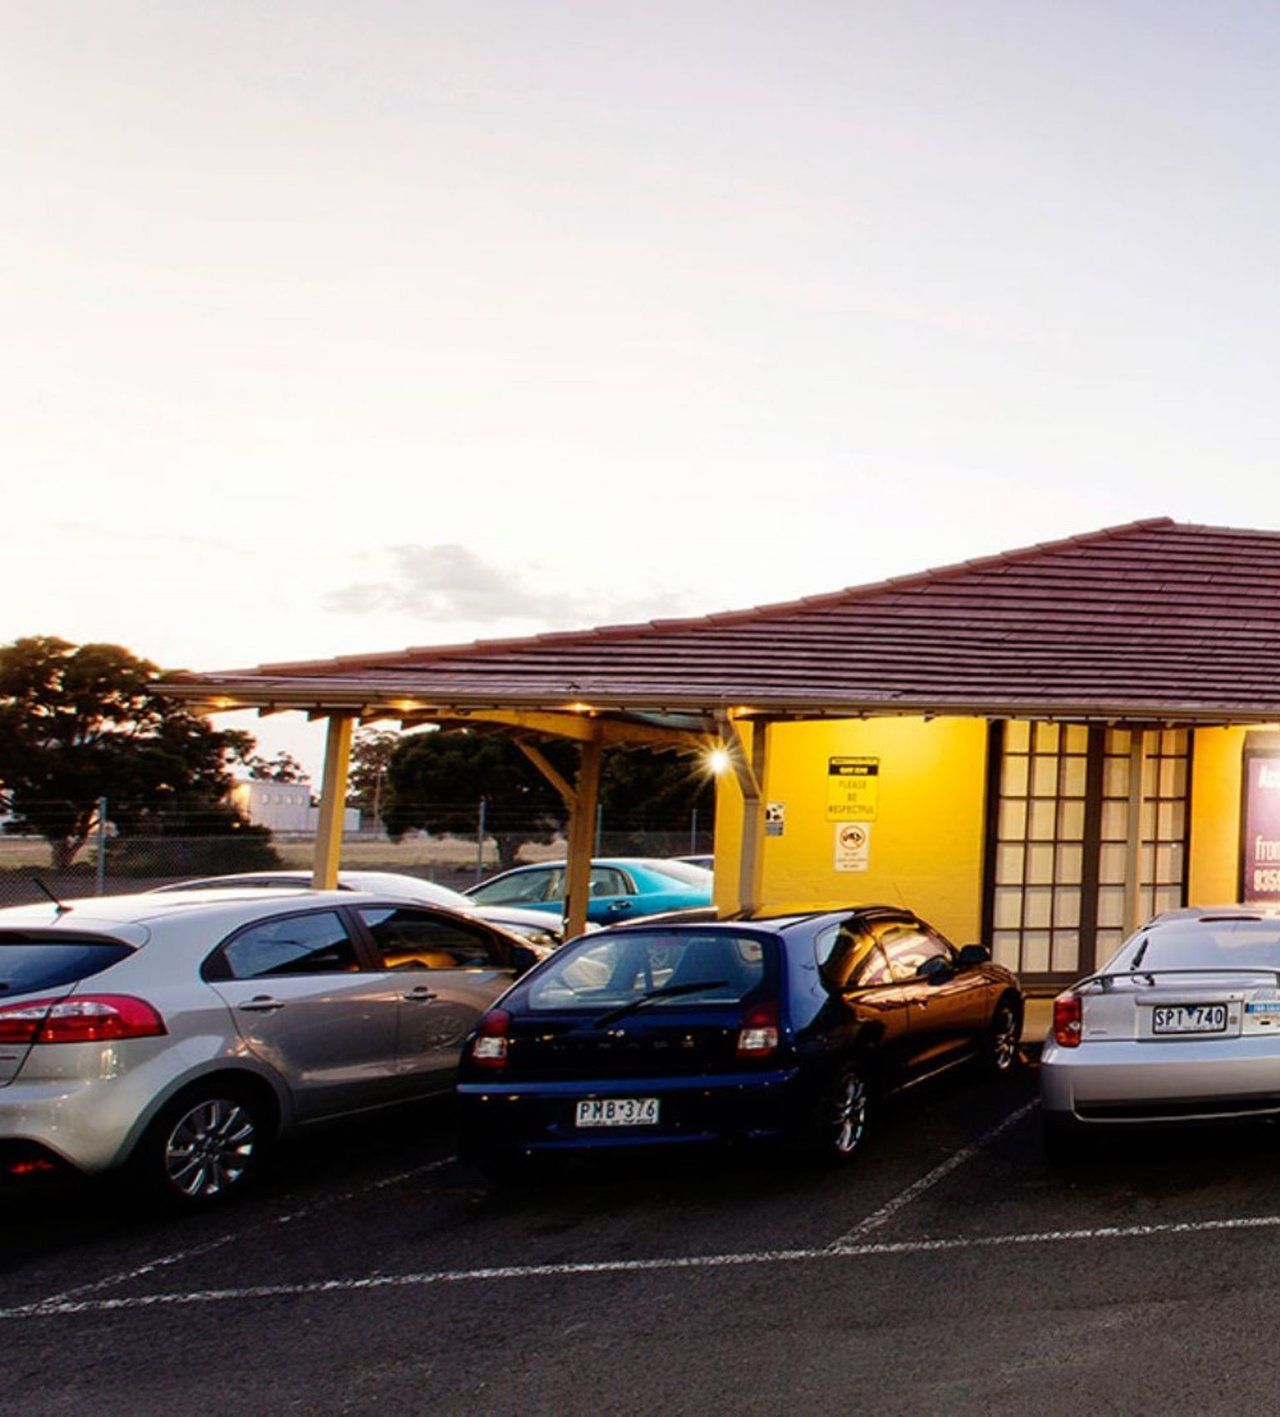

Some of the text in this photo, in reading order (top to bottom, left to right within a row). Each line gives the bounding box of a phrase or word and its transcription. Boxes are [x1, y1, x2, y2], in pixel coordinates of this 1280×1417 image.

[1155, 1008, 1223, 1026] SPT 740
[625, 1099, 655, 1118] 376
